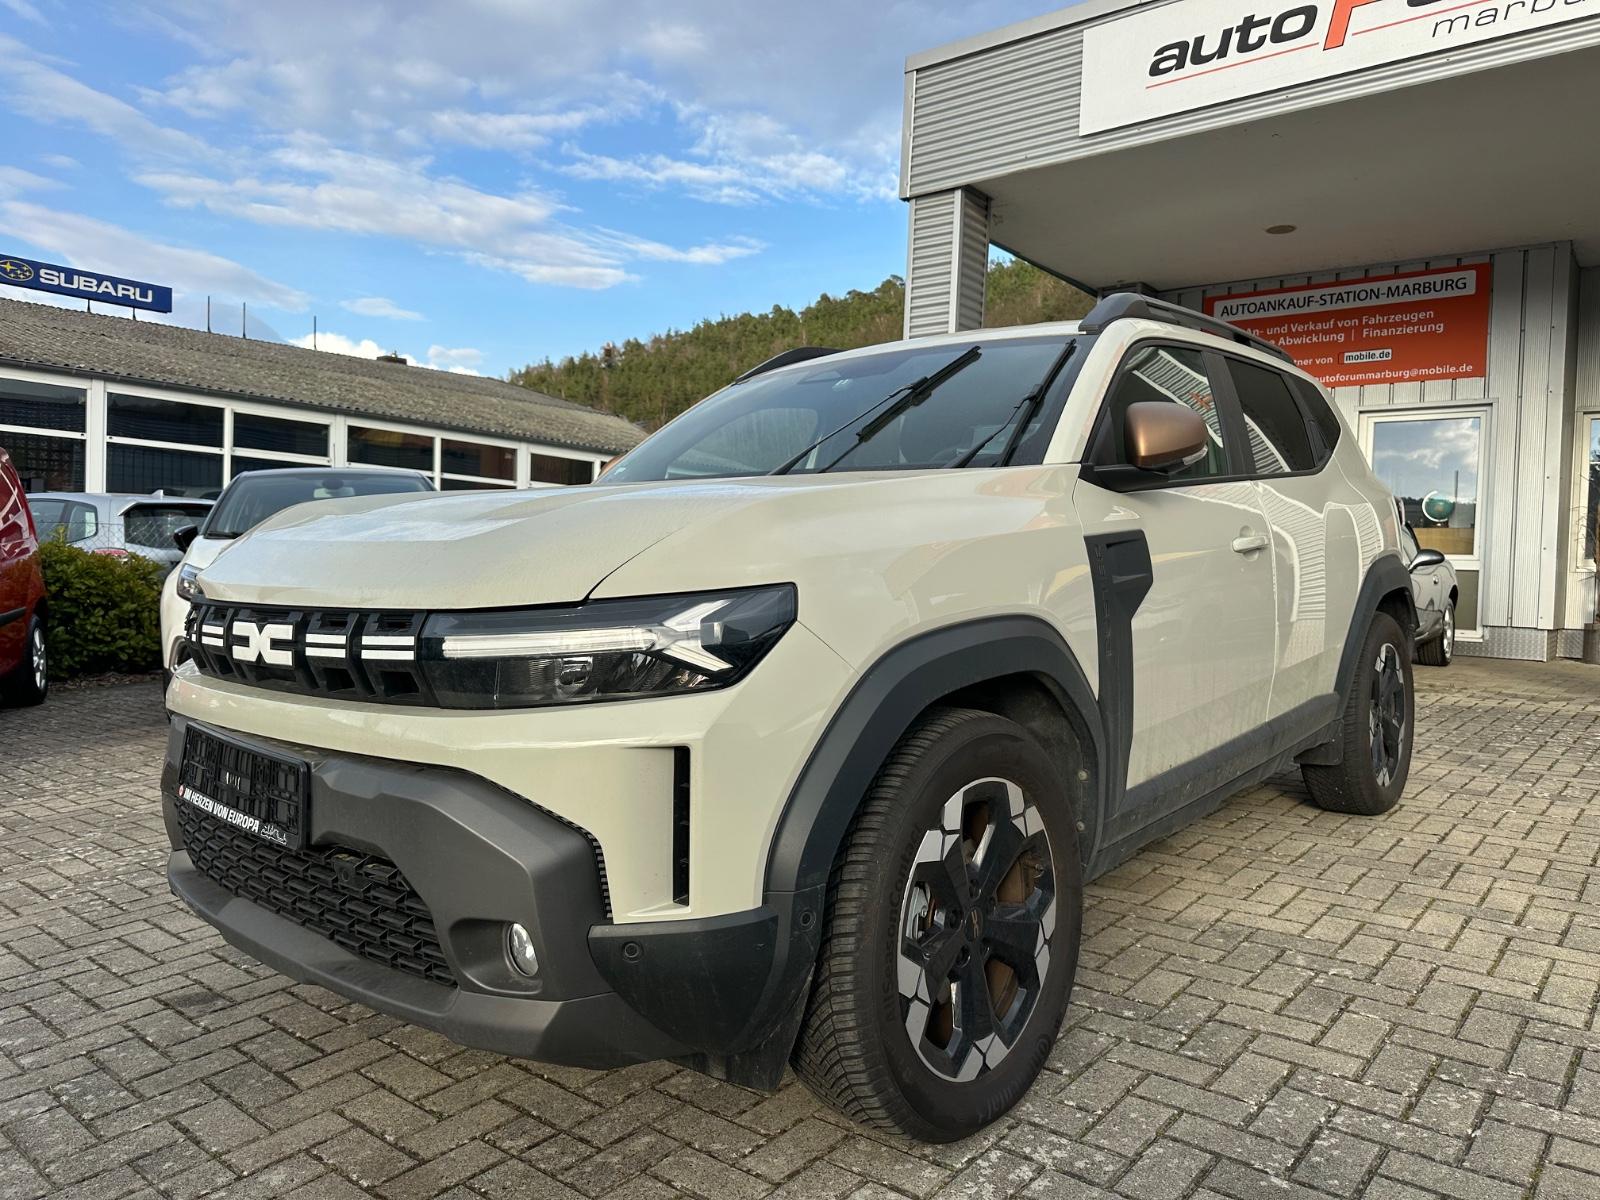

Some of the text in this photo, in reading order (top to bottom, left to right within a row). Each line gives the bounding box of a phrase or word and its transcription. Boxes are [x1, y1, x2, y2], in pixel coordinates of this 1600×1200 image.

[39, 268, 152, 302] SUBARU
[1220, 276, 1468, 317] AUTOANKAUF-STATION-MARBURG
[1266, 323, 1288, 335] und
[1290, 319, 1337, 333] Verkauf
[1339, 318, 1359, 328] von
[1362, 309, 1435, 326] Fahrzeugen
[1278, 321, 1444, 346] Abwicklung Finanzierung
[1315, 356, 1333, 365] von
[1345, 350, 1390, 362] mobile.de
[183, 788, 259, 833] IM HERZEN VON EUROPA
